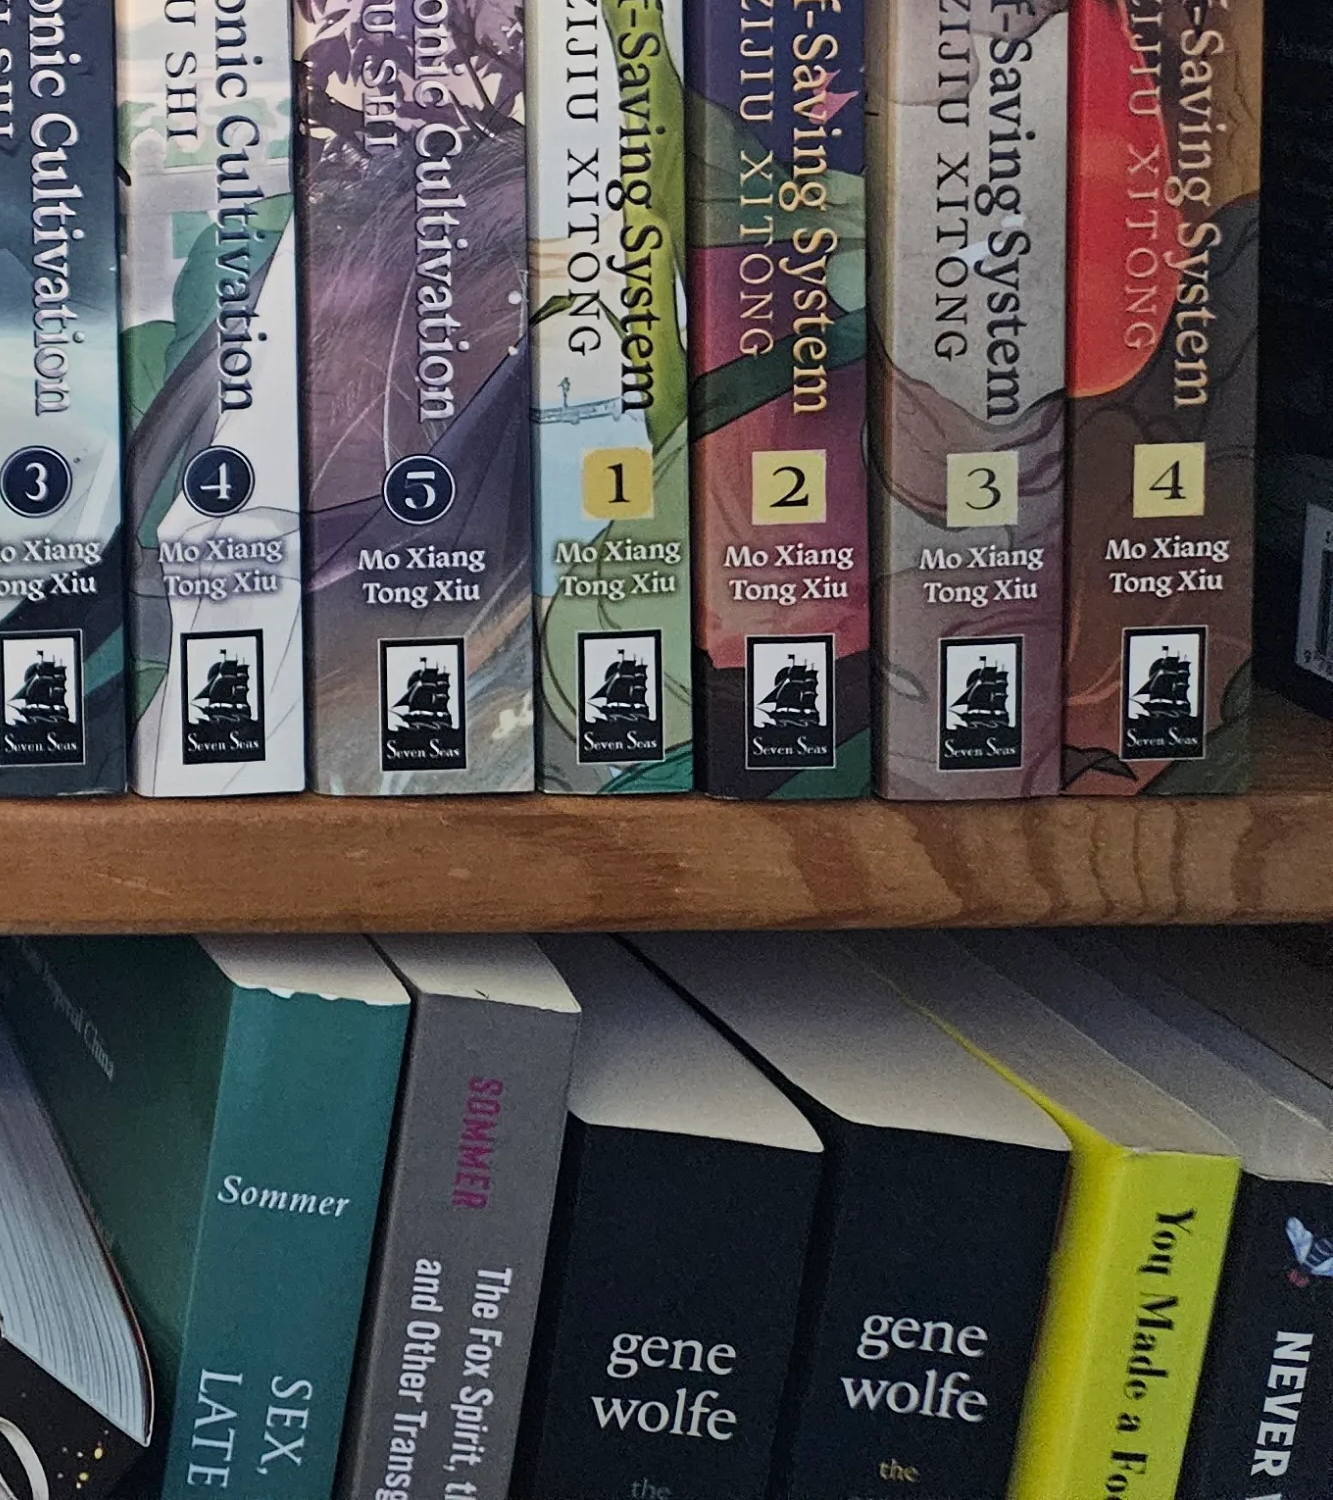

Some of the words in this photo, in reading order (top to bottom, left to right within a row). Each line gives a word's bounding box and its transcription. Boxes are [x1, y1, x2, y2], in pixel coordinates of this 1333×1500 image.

[30, 113, 84, 417] Cultivation
[739, 150, 774, 357] XITONG
[607, 224, 663, 411] System
[779, 227, 838, 415] System
[25, 463, 46, 501] 3
[201, 462, 230, 499] 4
[405, 471, 436, 509] 5
[607, 463, 631, 504] 1
[769, 466, 809, 508] 2
[965, 468, 1001, 510] 3
[1149, 460, 1186, 500] 4
[159, 541, 202, 563] Mo
[207, 539, 283, 563] Xiang
[920, 548, 961, 570] Mo
[966, 545, 1044, 570] Xiang
[165, 575, 227, 599] Tong
[232, 572, 277, 593] Xiu
[924, 581, 988, 607] Tong
[993, 578, 1037, 600] Xiu
[453, 1077, 503, 1211] SOMMER
[217, 1174, 351, 1218] Sommer
[1136, 1207, 1197, 1276] You
[410, 1258, 444, 1313] and
[471, 1267, 513, 1320] The
[398, 1320, 441, 1403] Other
[462, 1327, 503, 1378] Fox
[606, 1332, 737, 1379] gene
[856, 1313, 990, 1360] gene
[1123, 1292, 1178, 1400] Made
[591, 1387, 737, 1441] wolfe
[840, 1369, 988, 1423] wolfe
[1250, 1330, 1315, 1477] NEVER
[186, 1368, 243, 1489] LATE
[257, 1375, 313, 1476] SEX,
[443, 1386, 494, 1472] Spirit,
[1115, 1412, 1141, 1433] a
[879, 1458, 920, 1483] the
